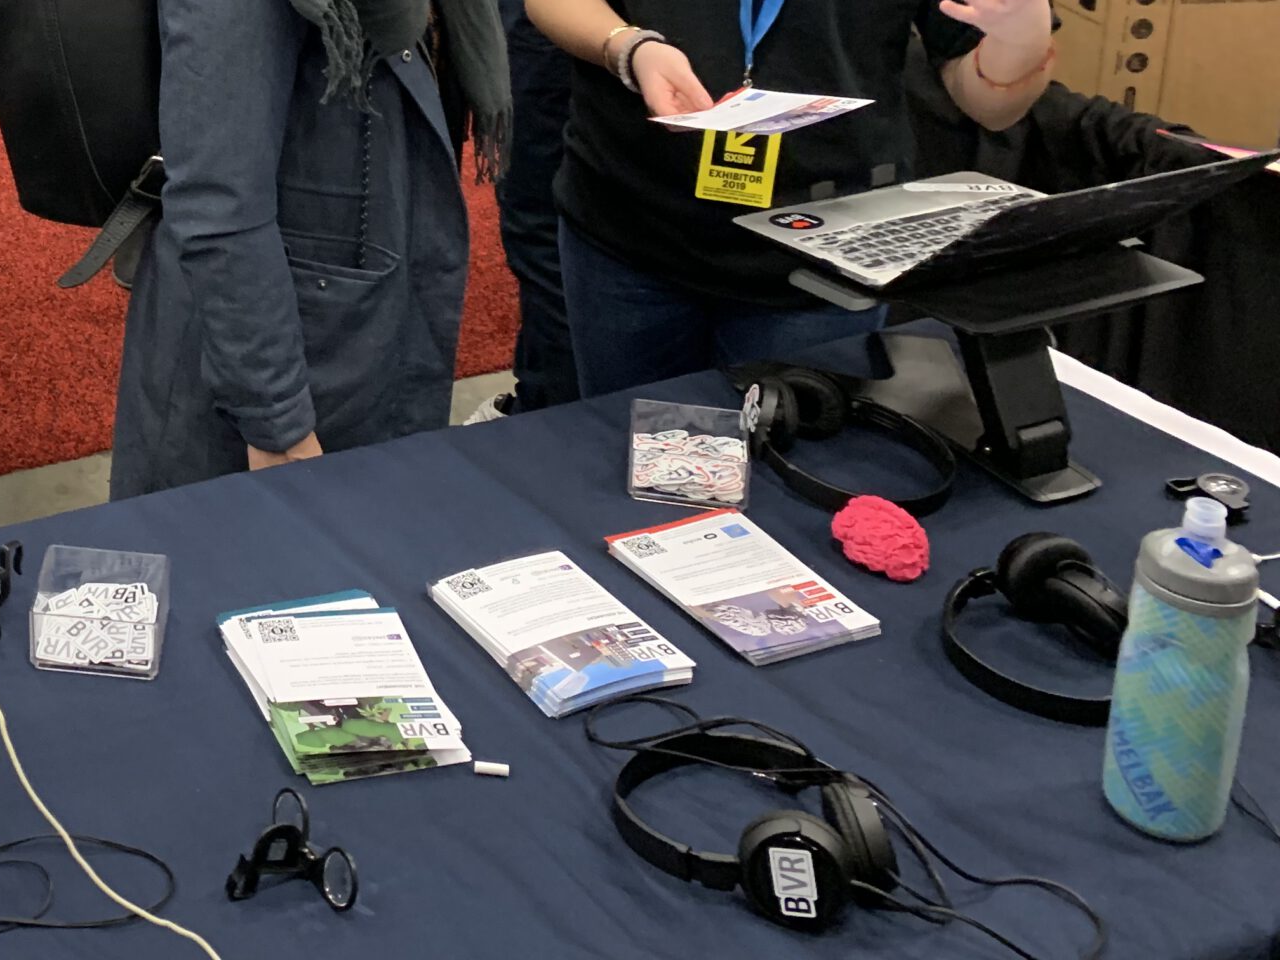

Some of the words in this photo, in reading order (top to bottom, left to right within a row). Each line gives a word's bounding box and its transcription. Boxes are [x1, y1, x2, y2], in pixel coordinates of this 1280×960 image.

[723, 152, 755, 165] SXSW
[708, 168, 763, 185] EXHIBITOR
[722, 179, 747, 191] 2019
[811, 602, 854, 623] BVR
[631, 643, 676, 660] BVR
[400, 722, 451, 738] BVR
[778, 856, 812, 914] BVR
